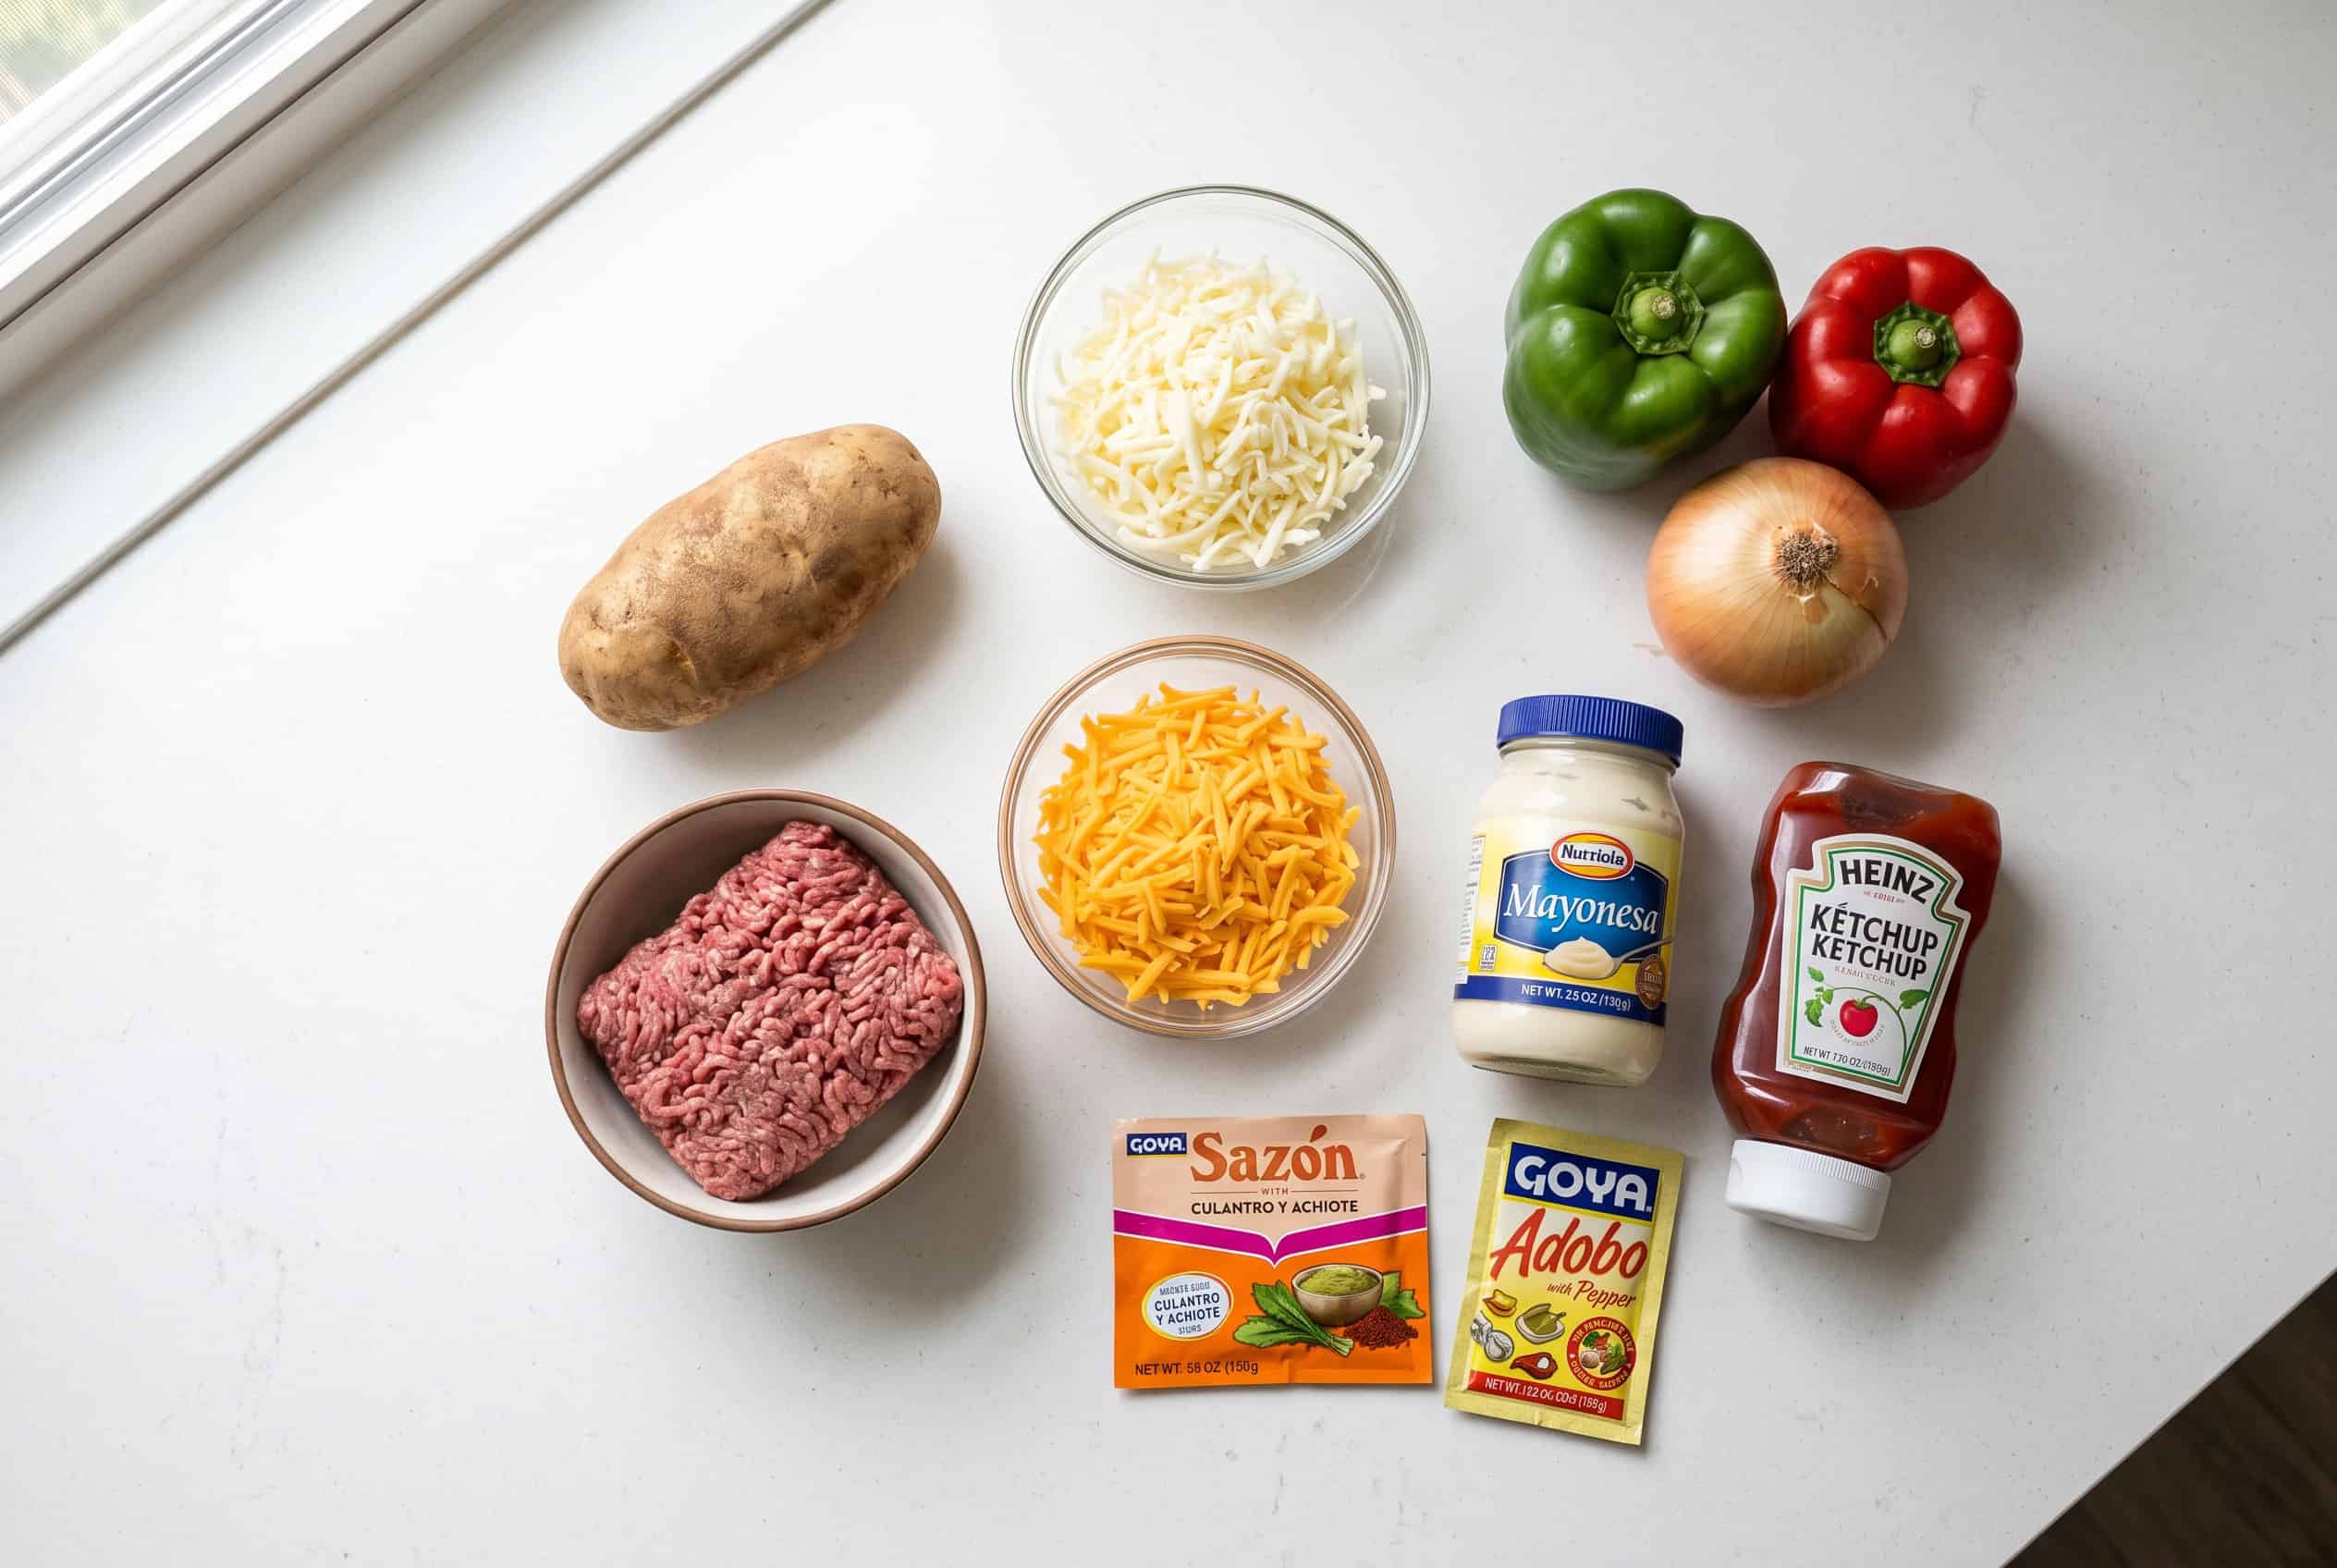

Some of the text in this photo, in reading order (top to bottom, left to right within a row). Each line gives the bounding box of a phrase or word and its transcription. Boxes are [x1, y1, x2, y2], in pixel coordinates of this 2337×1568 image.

[1840, 859, 1935, 904] HEINZ
[1503, 883, 1658, 935] Mayonesa
[1810, 902, 1939, 957] KÉTCHUP
[1811, 933, 1927, 981] KETCHUP
[1522, 984, 1543, 997] NET
[1545, 986, 1563, 999] WT.
[1581, 991, 1597, 1004] OZ
[1803, 1046, 1818, 1057] NET
[1191, 1124, 1359, 1182] Sazón
[1261, 1187, 1289, 1195] WITH
[1191, 1200, 1359, 1215] CULANTRO Y ACHIOTE
[1489, 1207, 1649, 1281] Adobo
[1155, 1292, 1220, 1311] CULANTRO
[1547, 1280, 1637, 1309] with Pepper
[1156, 1306, 1220, 1326] Y ACHIOTE
[1135, 1363, 1159, 1376] NET
[1204, 1361, 1220, 1373] OZ
[1486, 1377, 1504, 1390] NET
